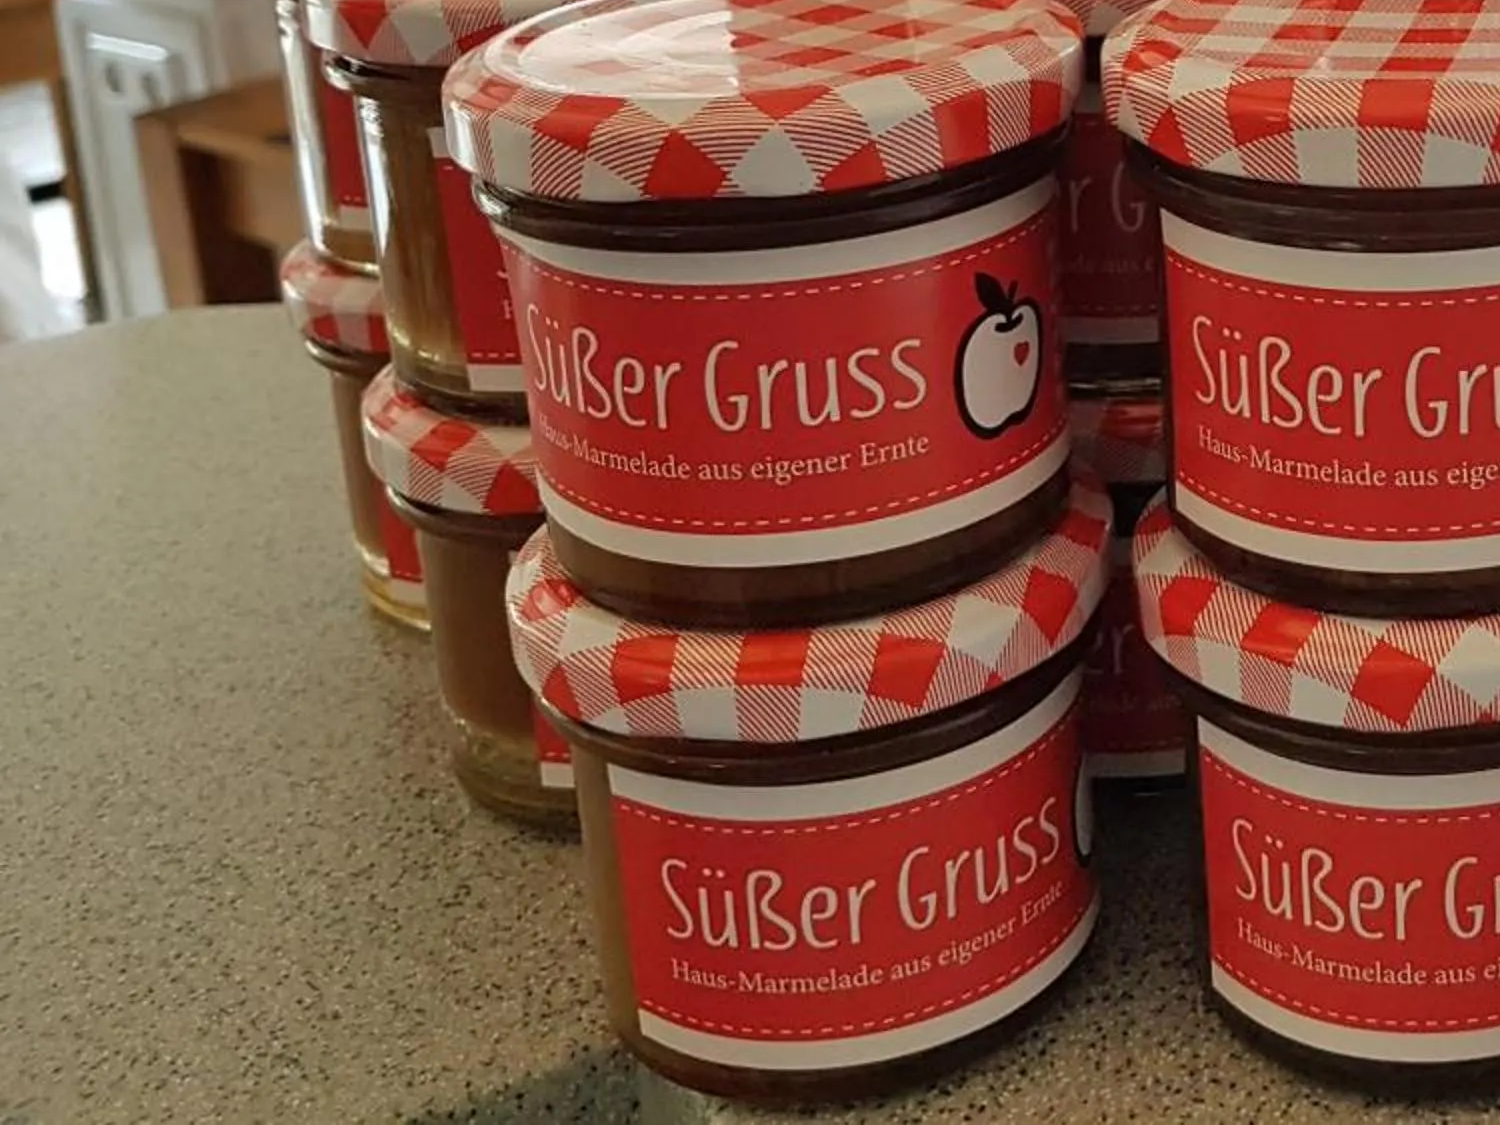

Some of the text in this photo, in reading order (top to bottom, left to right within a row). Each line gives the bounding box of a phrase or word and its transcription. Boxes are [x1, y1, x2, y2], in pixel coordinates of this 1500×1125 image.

[528, 303, 929, 433] Süßer Gruss
[1192, 314, 1383, 439] Süßer
[535, 410, 931, 487] Haus-Marmelade aus eigener Ernte
[1198, 425, 1388, 488] Haus-Marmelade
[1394, 467, 1440, 488] aus
[660, 796, 1060, 952] Süßer Gruss
[1231, 817, 1424, 942] Süßer
[670, 878, 1065, 996] Haus-Marmelade aus eigener Ernte
[1237, 917, 1428, 987] Haus-Marmelade
[1433, 961, 1478, 987] aus
